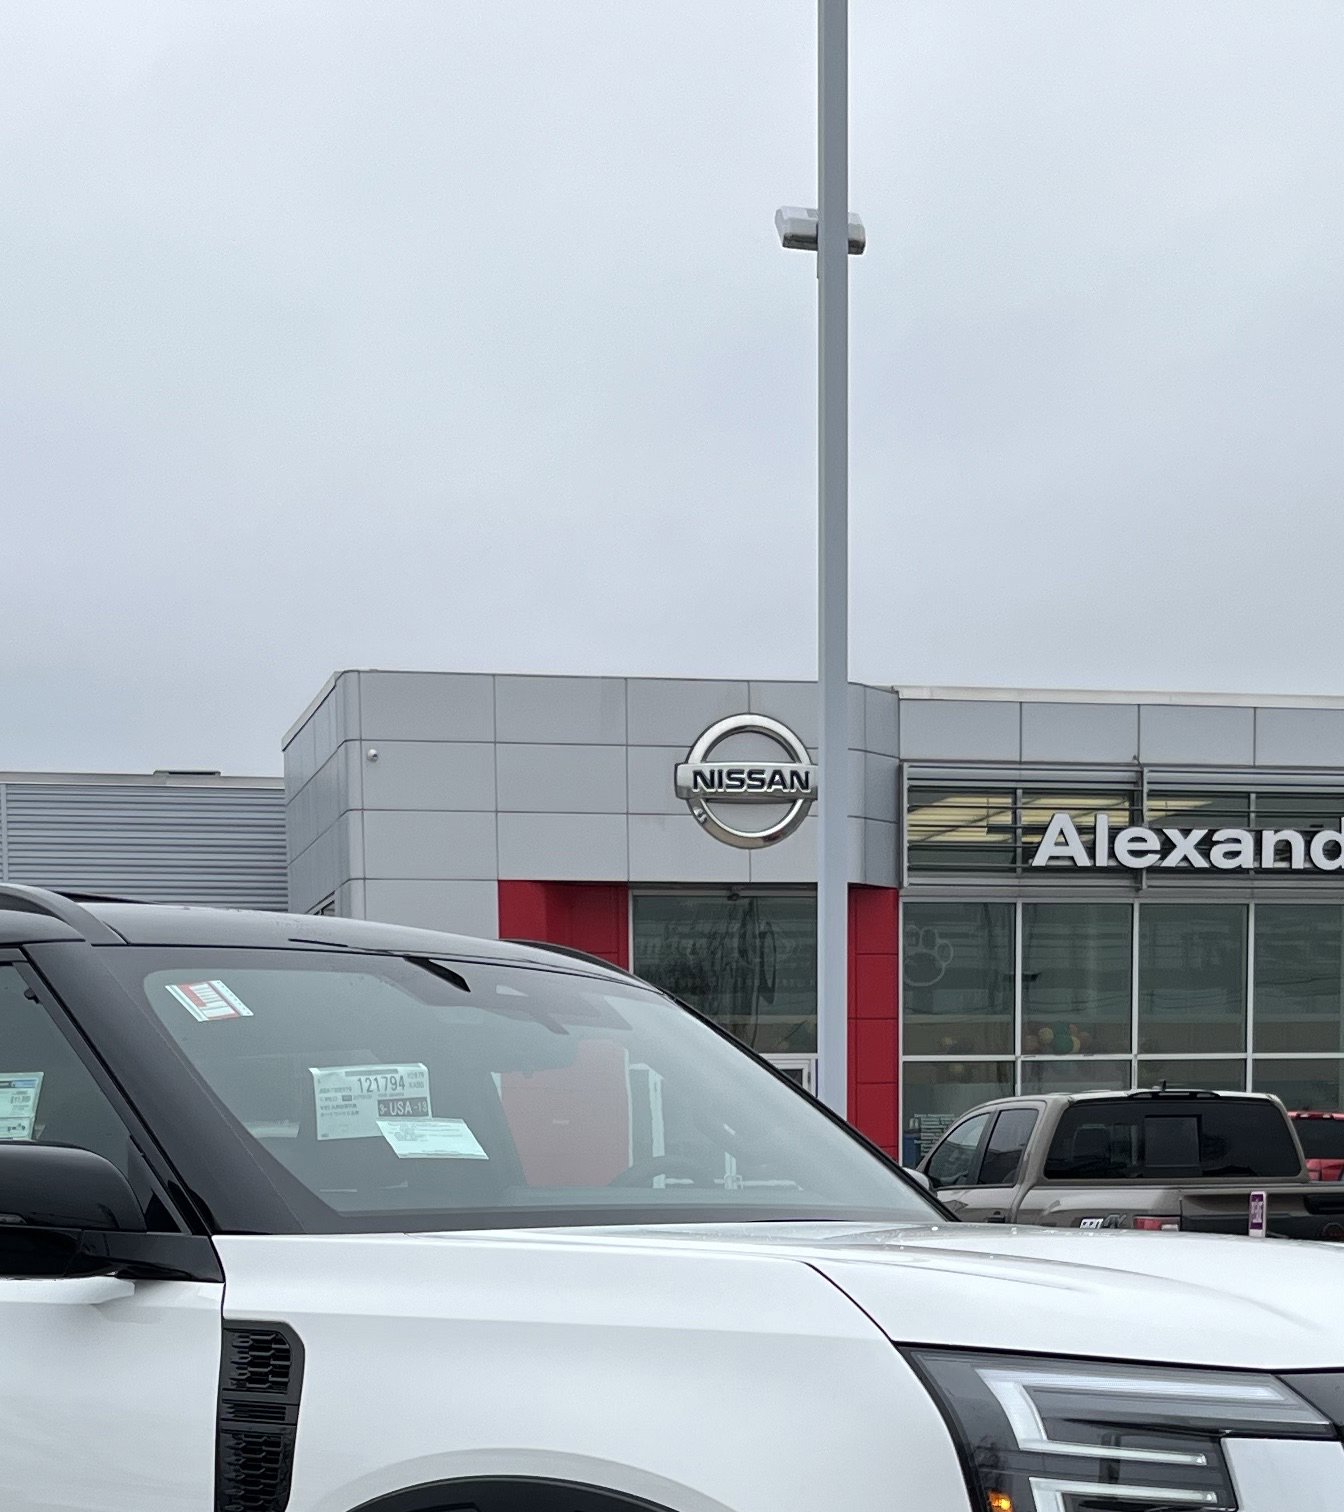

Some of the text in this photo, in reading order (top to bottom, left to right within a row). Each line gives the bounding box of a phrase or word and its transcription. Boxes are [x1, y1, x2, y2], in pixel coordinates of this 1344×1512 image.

[692, 769, 812, 793] NISSAN
[357, 1075, 406, 1094] 121794
[389, 1100, 413, 1116] USA
